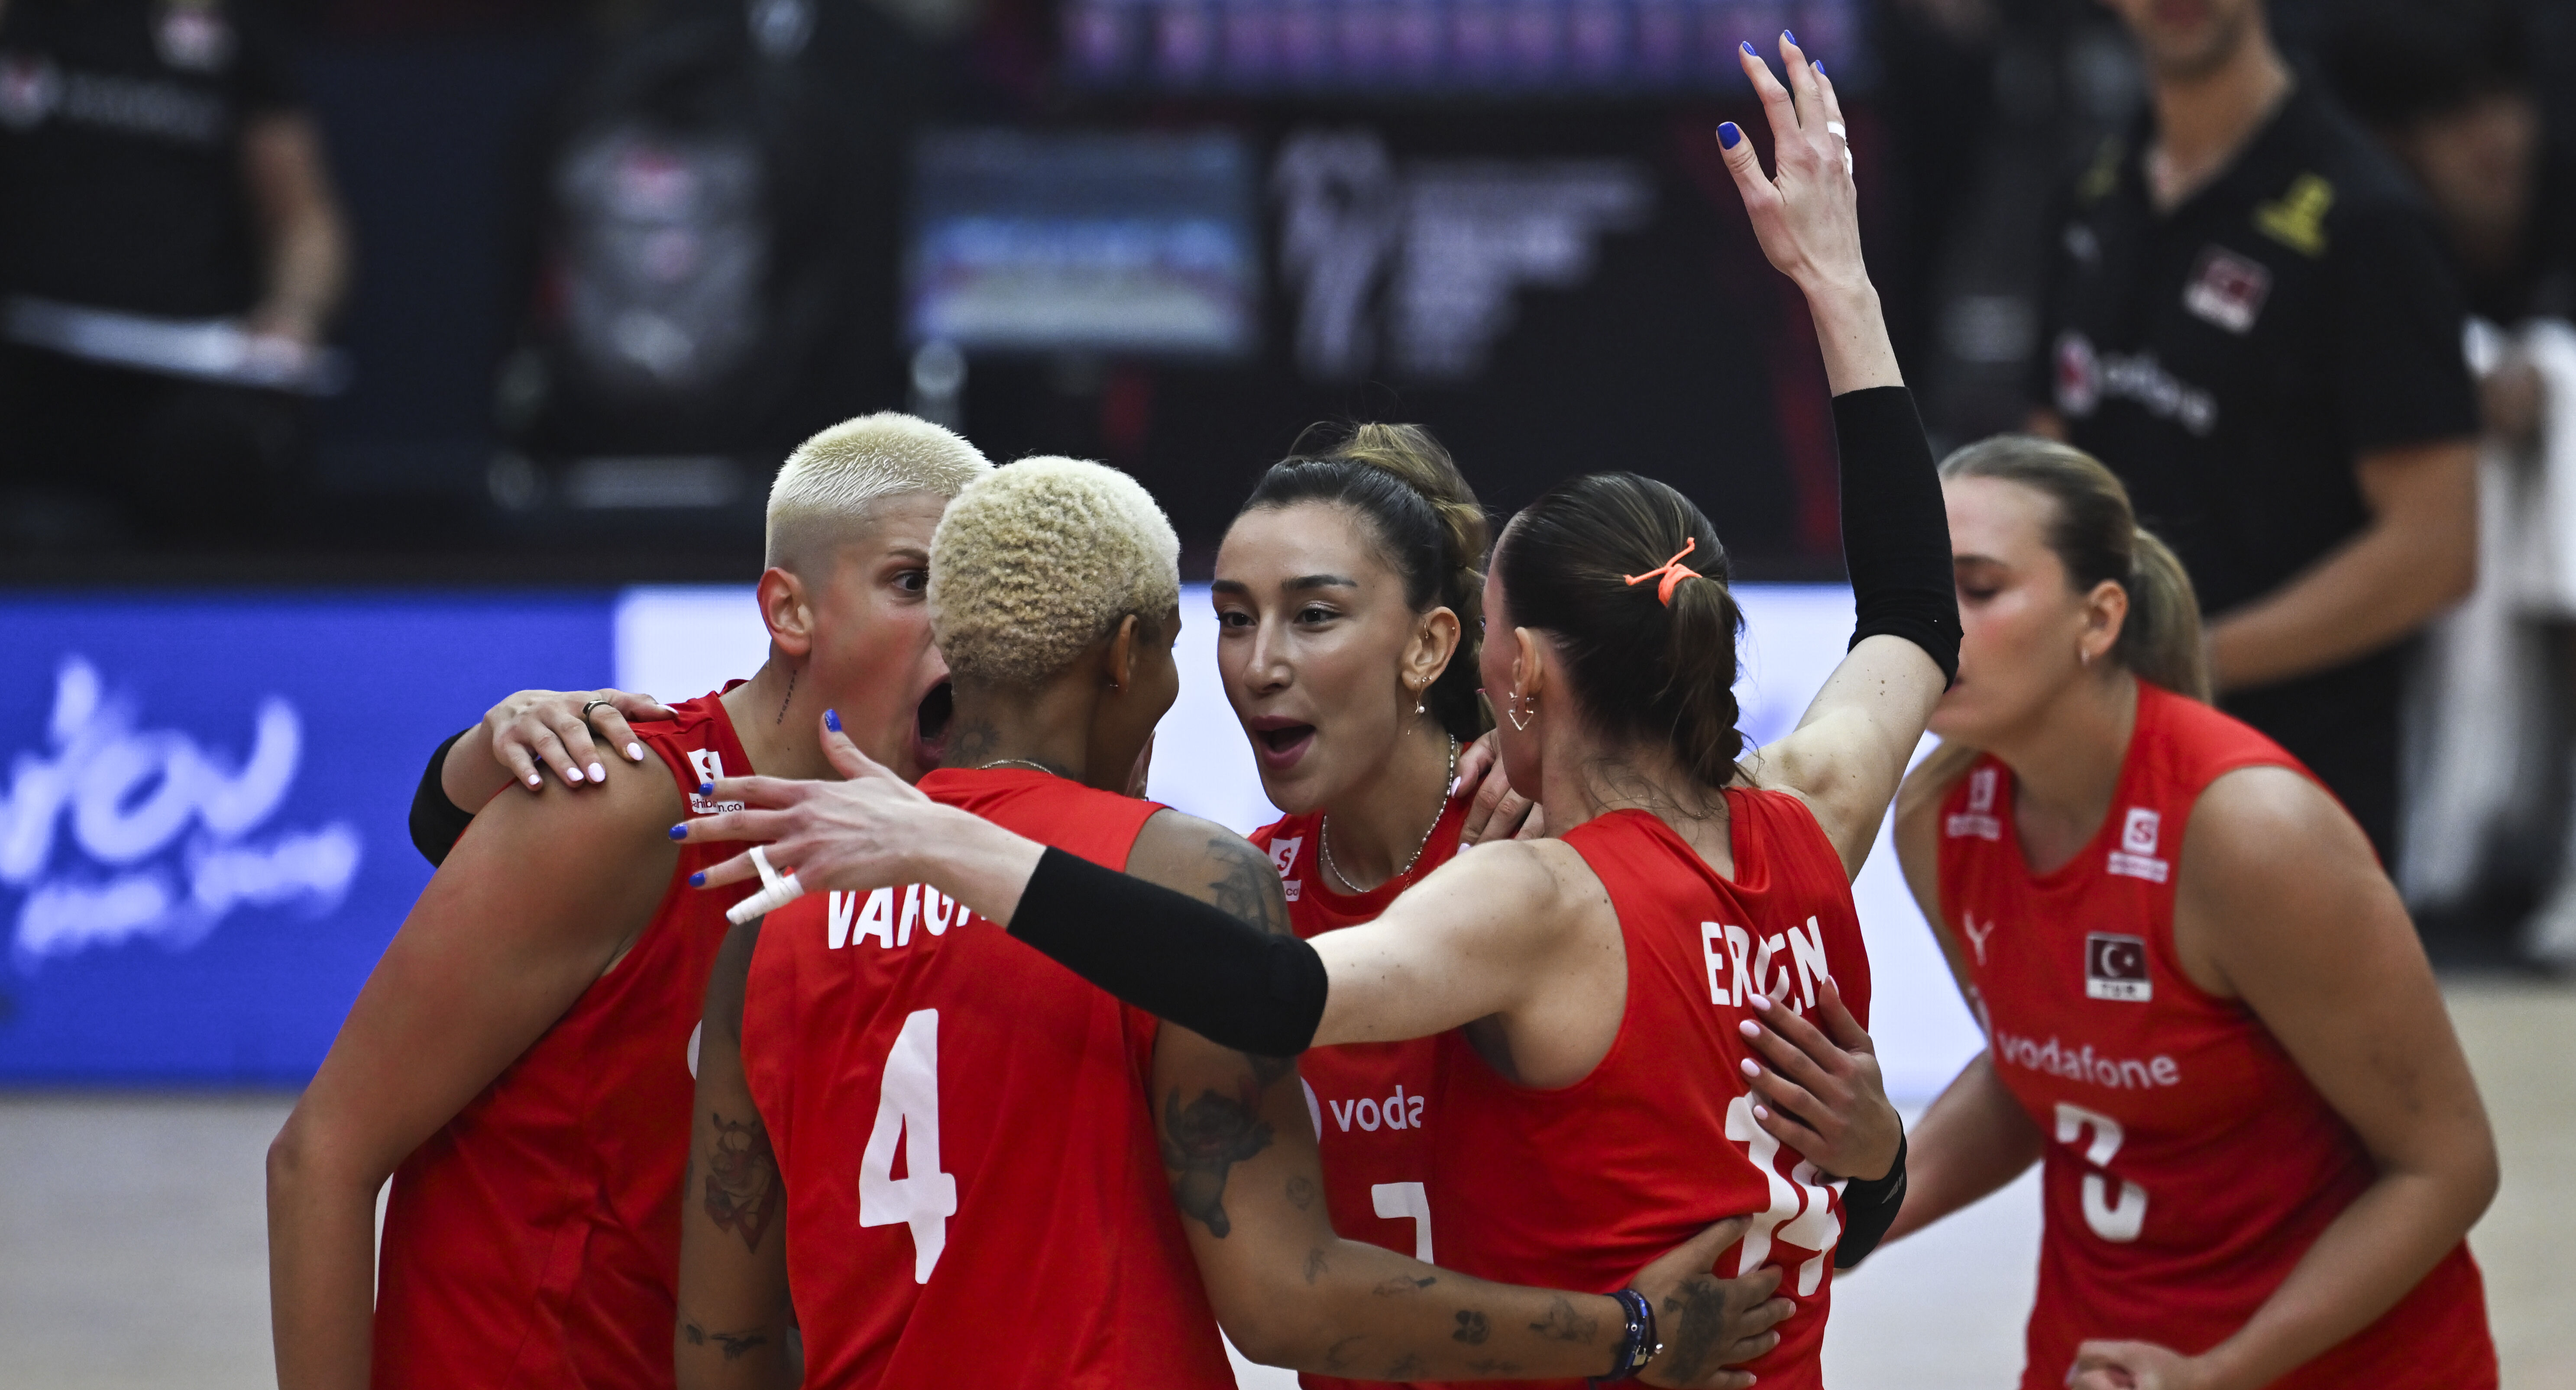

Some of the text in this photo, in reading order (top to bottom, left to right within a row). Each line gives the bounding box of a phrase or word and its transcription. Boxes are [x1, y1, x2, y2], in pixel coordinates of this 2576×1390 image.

[1277, 847, 1291, 872] S
[1996, 1031, 2181, 1090] vodafone
[1329, 1085, 1424, 1132] voda
[859, 1008, 957, 1284] 4
[1371, 1182, 1434, 1265] 7
[1725, 1091, 1849, 1297] 14
